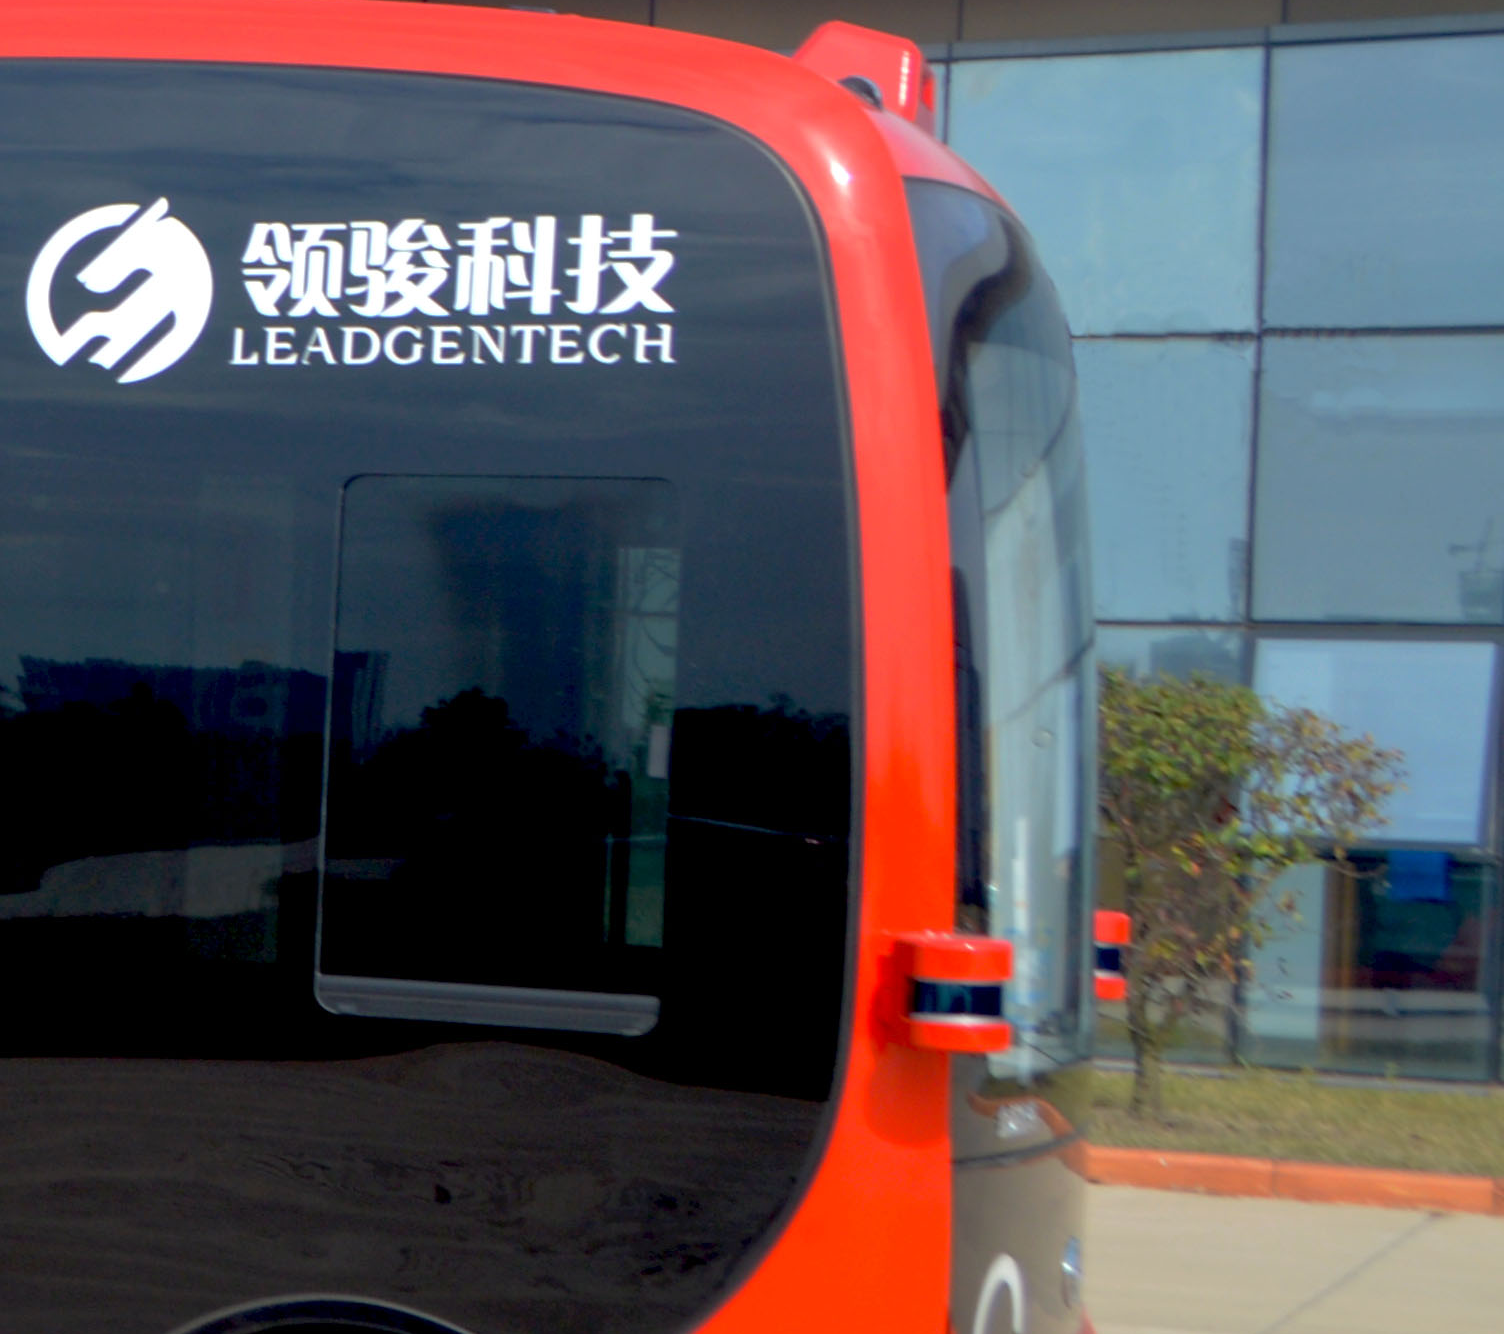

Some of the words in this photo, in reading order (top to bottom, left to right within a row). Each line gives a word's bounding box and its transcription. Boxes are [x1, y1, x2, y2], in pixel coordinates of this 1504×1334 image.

[241, 213, 678, 318] 领骏科技
[229, 323, 676, 365] LEADGENTECH
